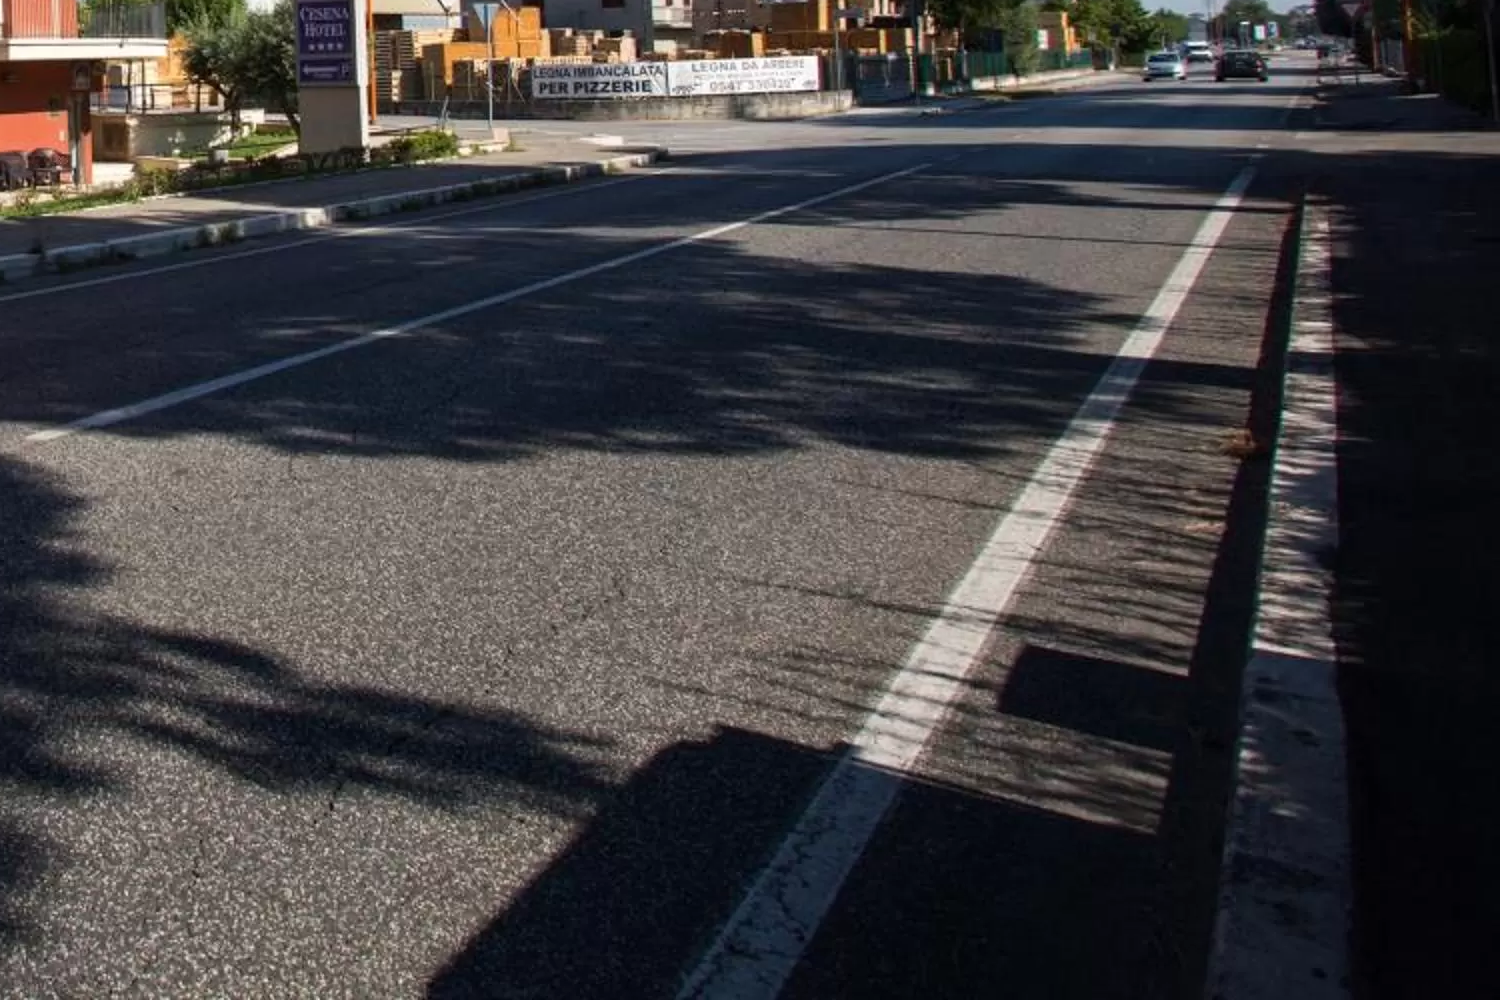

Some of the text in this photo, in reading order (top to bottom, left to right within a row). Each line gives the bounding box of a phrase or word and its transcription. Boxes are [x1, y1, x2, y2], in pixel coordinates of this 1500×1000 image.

[300, 7, 349, 21] CESENA
[304, 23, 347, 37] HOTEL
[533, 65, 664, 79] LEGNA IMBANCALATA
[691, 61, 737, 73] LEGNA
[741, 61, 759, 70] DA
[539, 80, 653, 95] PER PIZZERIE
